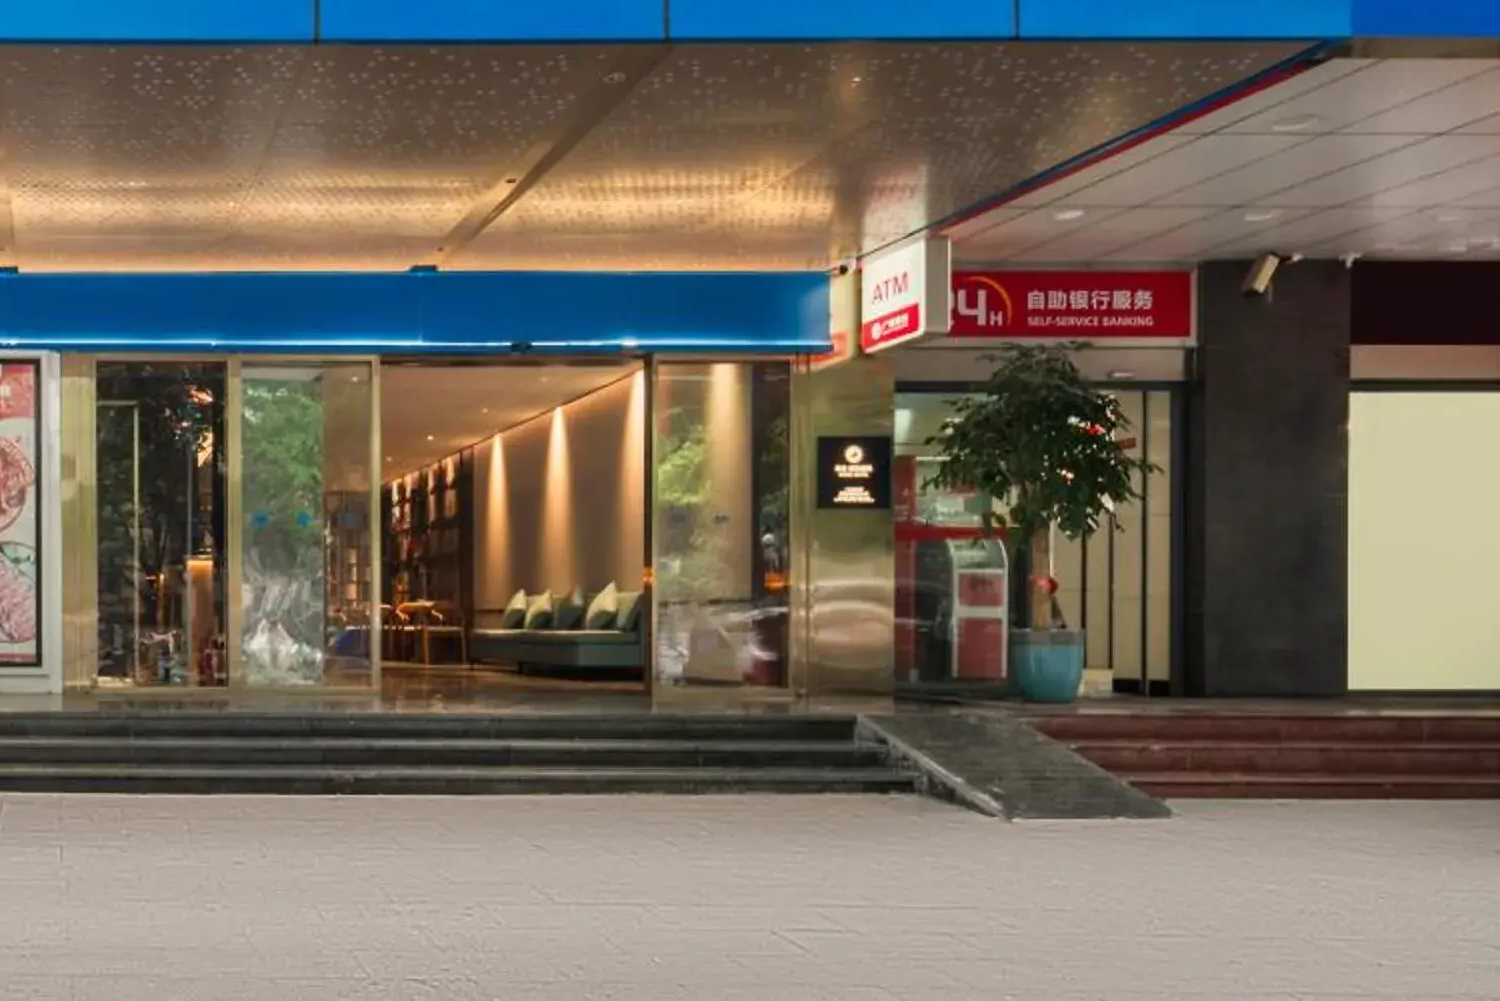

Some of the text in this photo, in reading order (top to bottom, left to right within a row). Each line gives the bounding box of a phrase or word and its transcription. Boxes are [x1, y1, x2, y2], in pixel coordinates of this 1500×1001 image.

[871, 271, 910, 305] ATM
[1026, 288, 1153, 310] 自助银行服务
[1026, 315, 1155, 327] SELF-SERVICE BANKING
